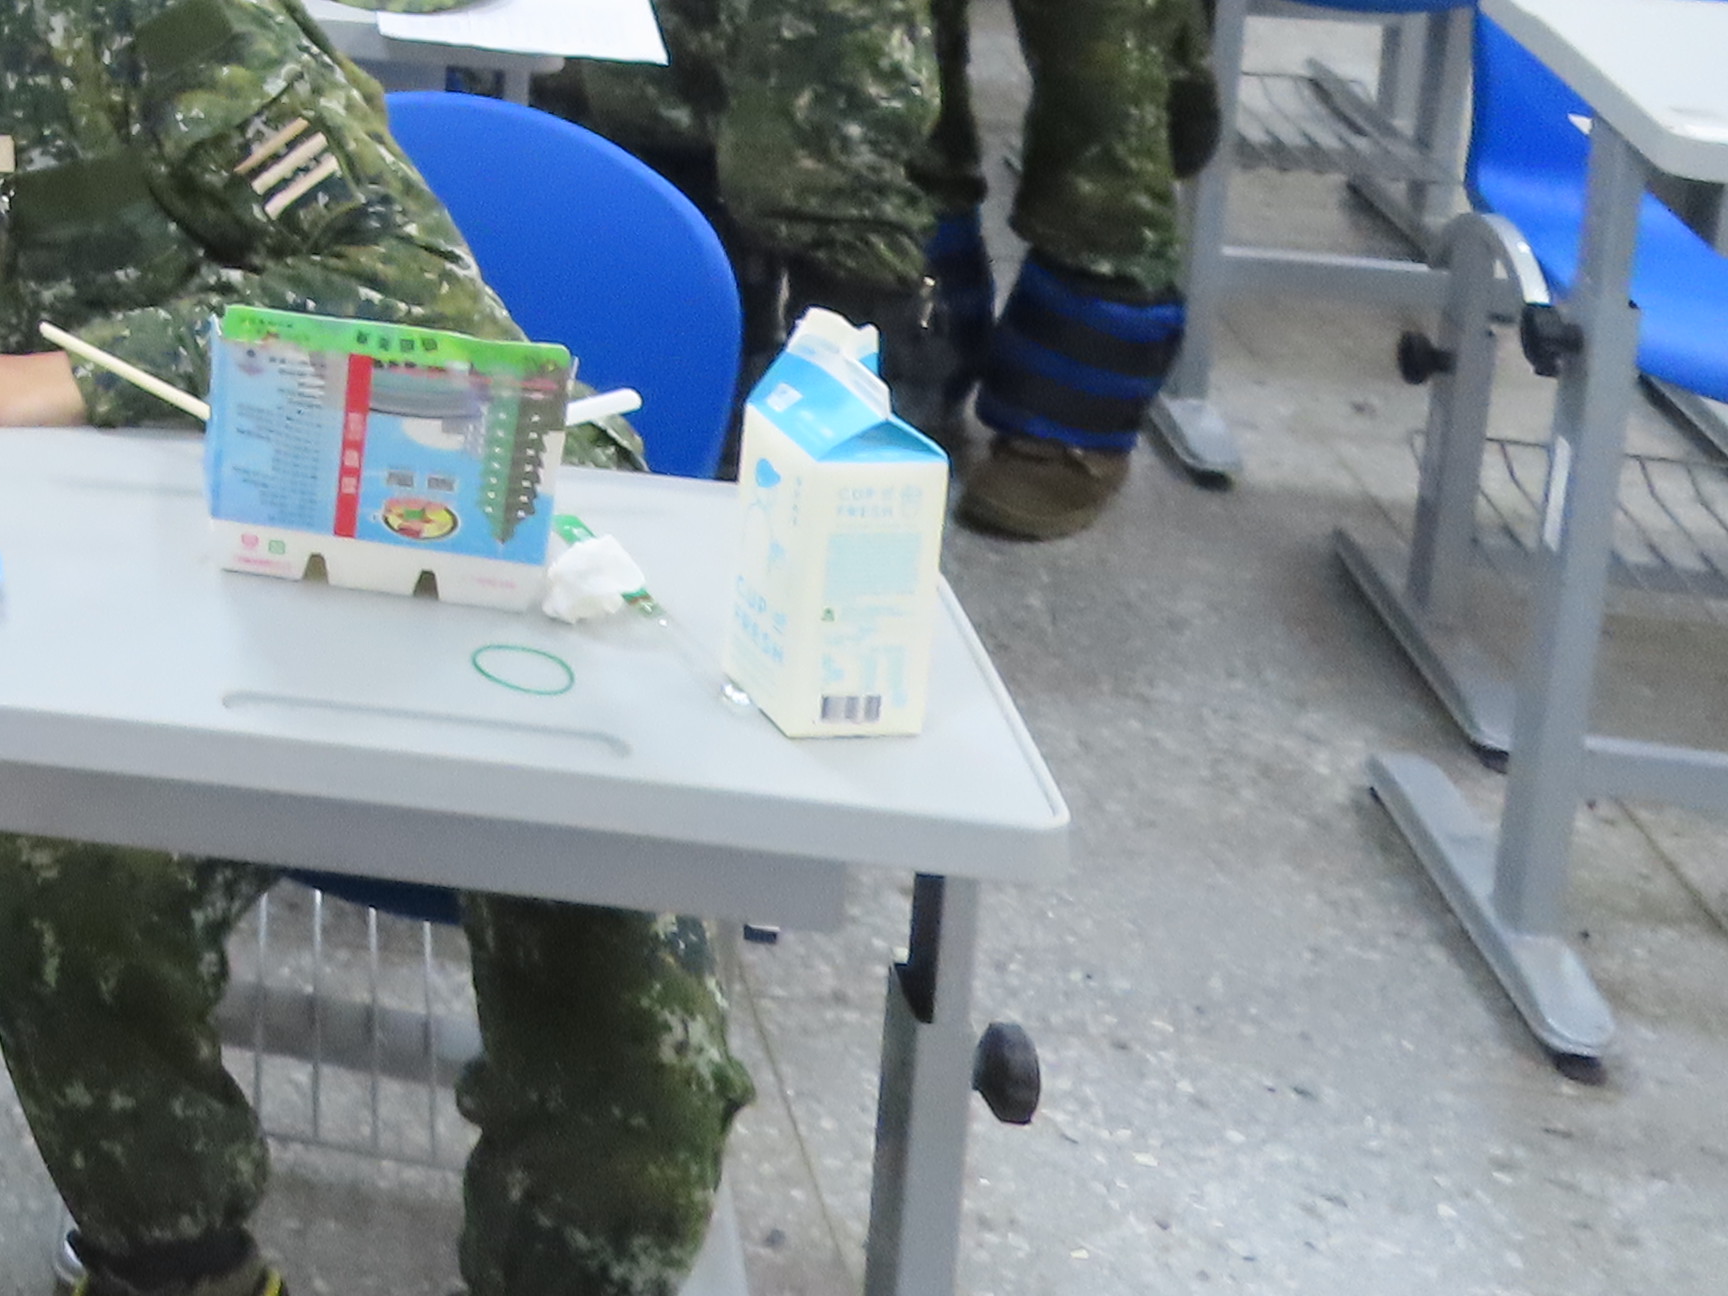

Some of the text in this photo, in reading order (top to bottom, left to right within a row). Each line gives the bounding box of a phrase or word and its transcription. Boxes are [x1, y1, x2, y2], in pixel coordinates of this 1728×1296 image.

[836, 504, 893, 518] FRESH
[735, 573, 767, 614] CUP
[733, 601, 785, 663] FRESH
